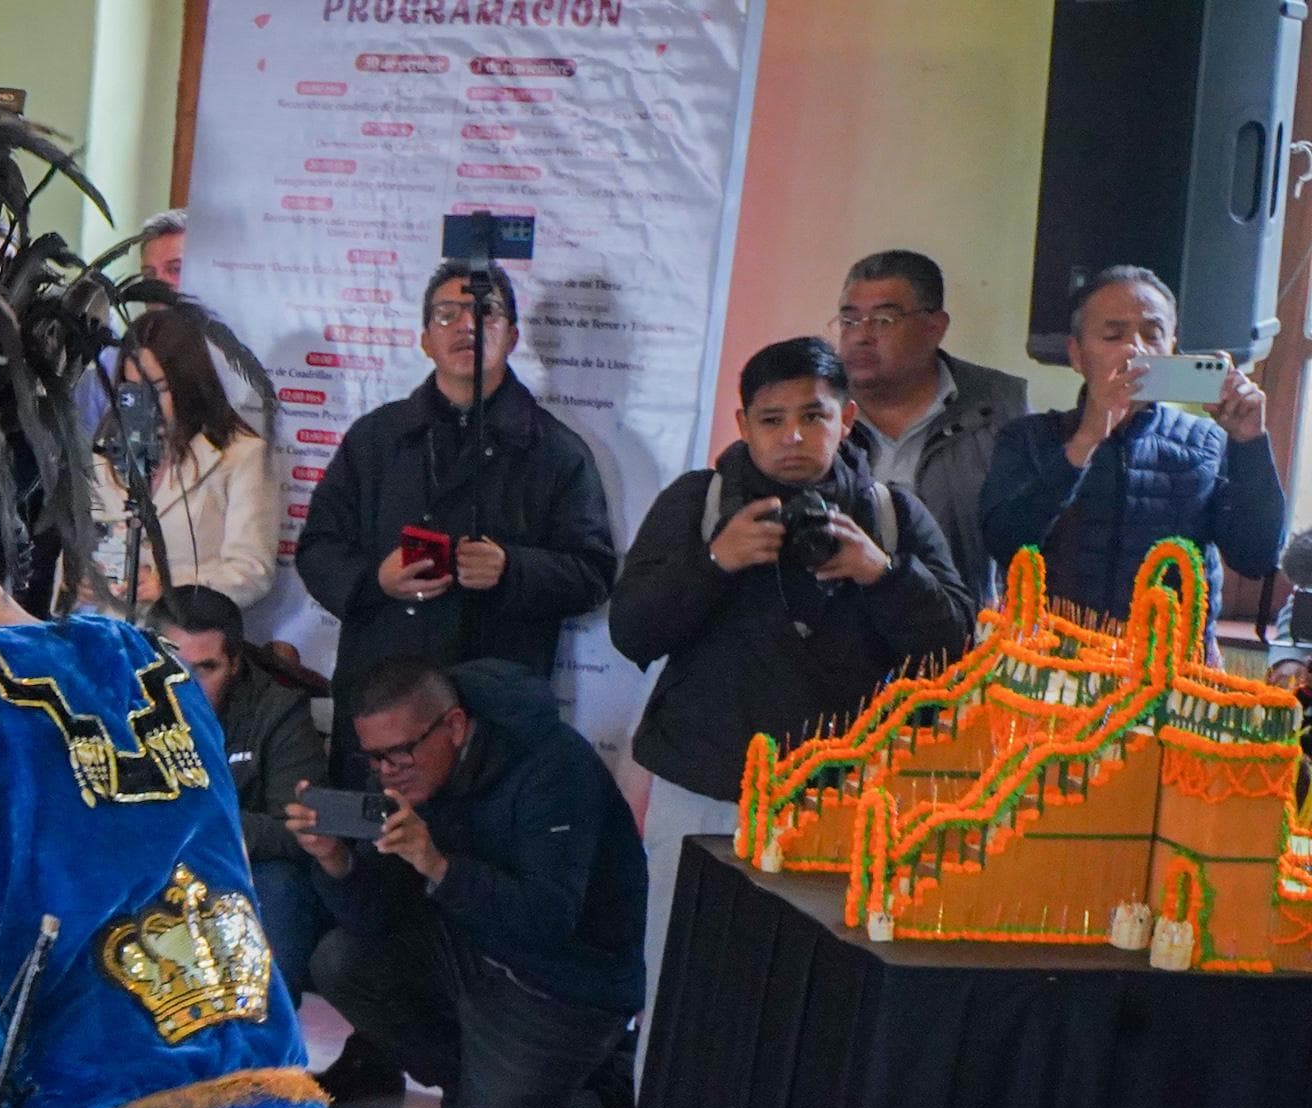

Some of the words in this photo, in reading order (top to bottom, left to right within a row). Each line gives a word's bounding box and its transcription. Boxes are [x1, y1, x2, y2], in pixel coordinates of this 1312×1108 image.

[504, 59, 570, 76] noviembre
[577, 317, 589, 328] de
[581, 356, 593, 367] de
[596, 357, 605, 368] la
[288, 368, 333, 380] Cuadrillas
[563, 395, 614, 410] Municipio
